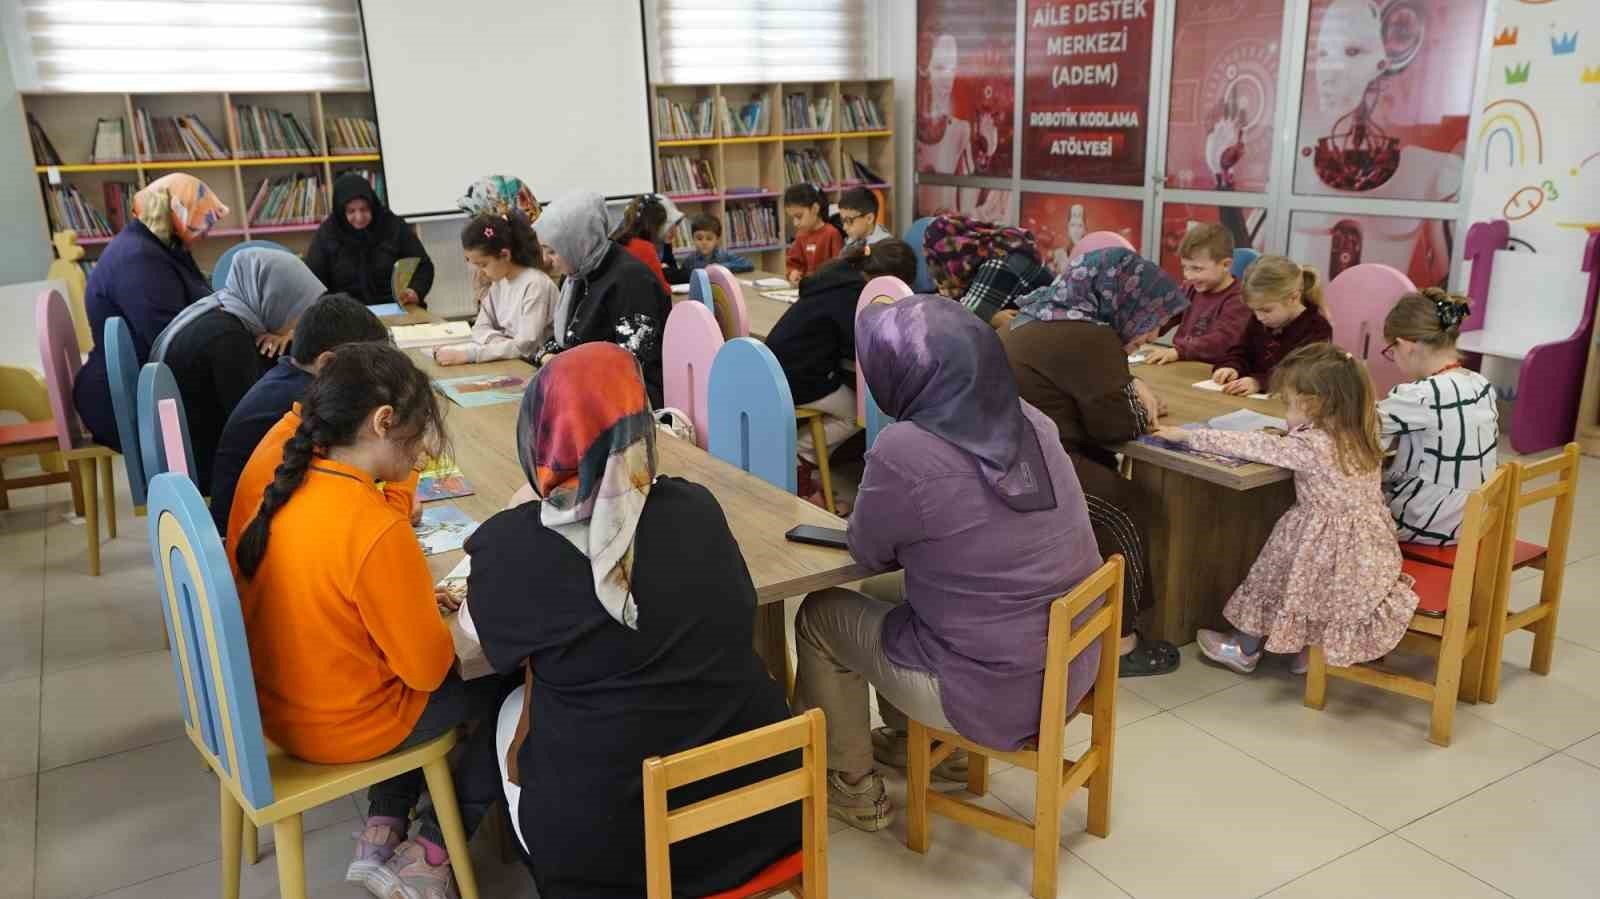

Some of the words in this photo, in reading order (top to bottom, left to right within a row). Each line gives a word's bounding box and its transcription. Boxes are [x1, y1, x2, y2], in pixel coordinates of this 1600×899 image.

[1032, 2, 1071, 28] AİLE
[1074, 0, 1147, 24] DESTEK
[1047, 25, 1128, 56] MERKEZİ
[1052, 60, 1118, 88] (ADEM)
[1030, 106, 1078, 127] ROBOTİK
[1079, 111, 1139, 127] KODLAMA
[1050, 136, 1112, 156] ATÖLYESİ
